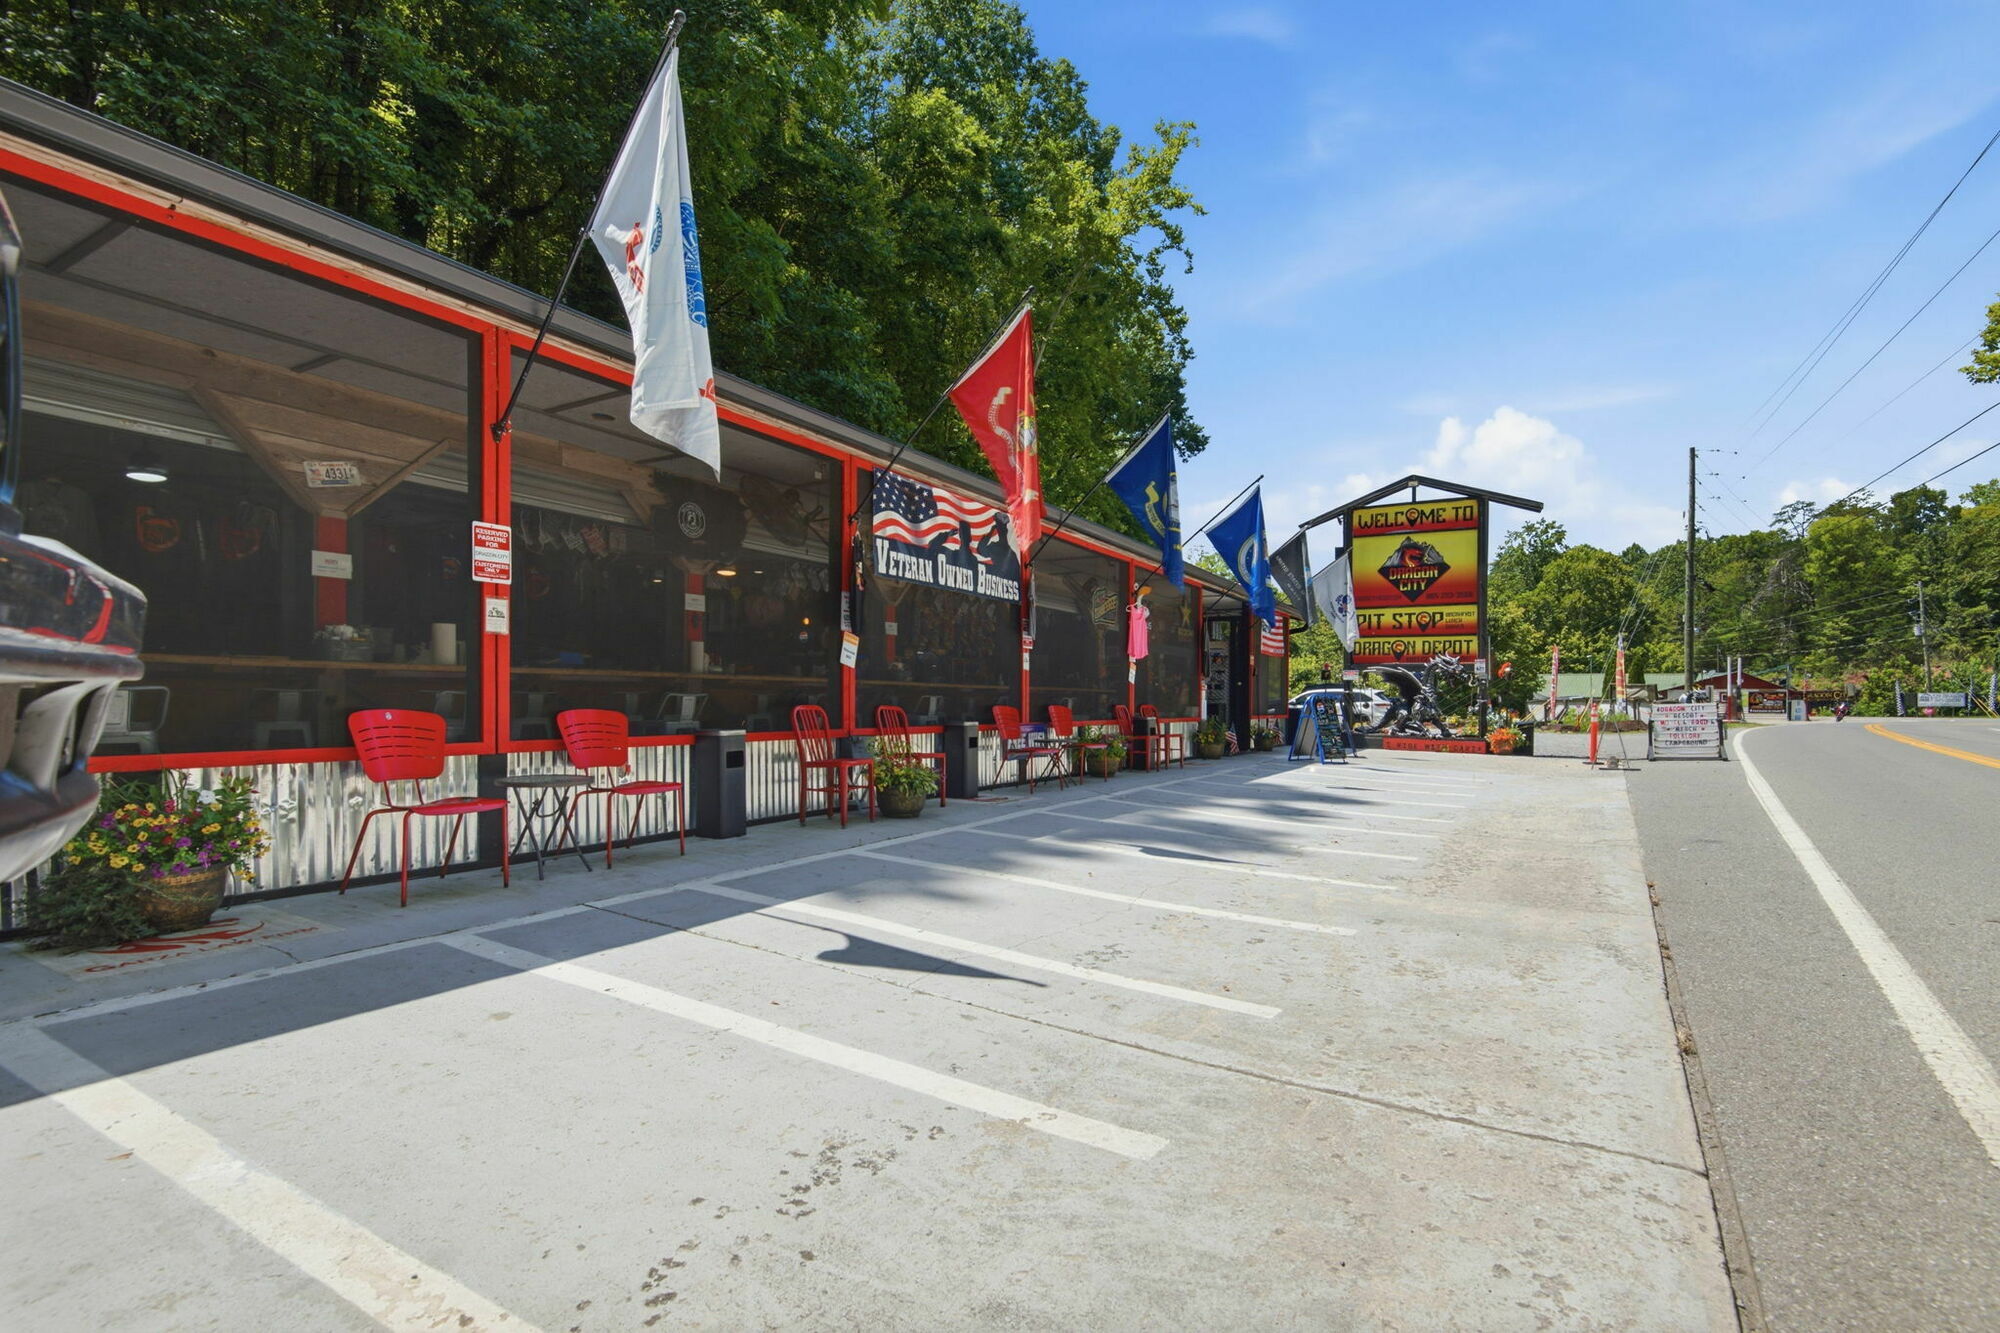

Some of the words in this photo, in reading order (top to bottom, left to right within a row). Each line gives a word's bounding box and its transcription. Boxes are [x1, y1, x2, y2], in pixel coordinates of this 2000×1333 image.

[325, 467, 349, 480] 4331
[1358, 507, 1447, 528] WELCOME
[1452, 505, 1474, 522] TO
[475, 527, 509, 538] RESERVED
[477, 534, 507, 544] PARKING
[475, 561, 509, 570] CUSTOMERS
[875, 538, 934, 584] VETERAN
[937, 553, 974, 591] OWNED
[977, 564, 1020, 602] BUSINESS
[1389, 567, 1439, 580] DRAGON
[1399, 579, 1427, 591] CITY
[1357, 613, 1385, 631] PIT
[1392, 611, 1444, 633] STOP
[1354, 640, 1416, 661] DRAGON
[1422, 639, 1473, 656] DEPOT
[84, 951, 193, 973] GARZA
[198, 938, 255, 953] LAW
[262, 925, 320, 940] FIRM
